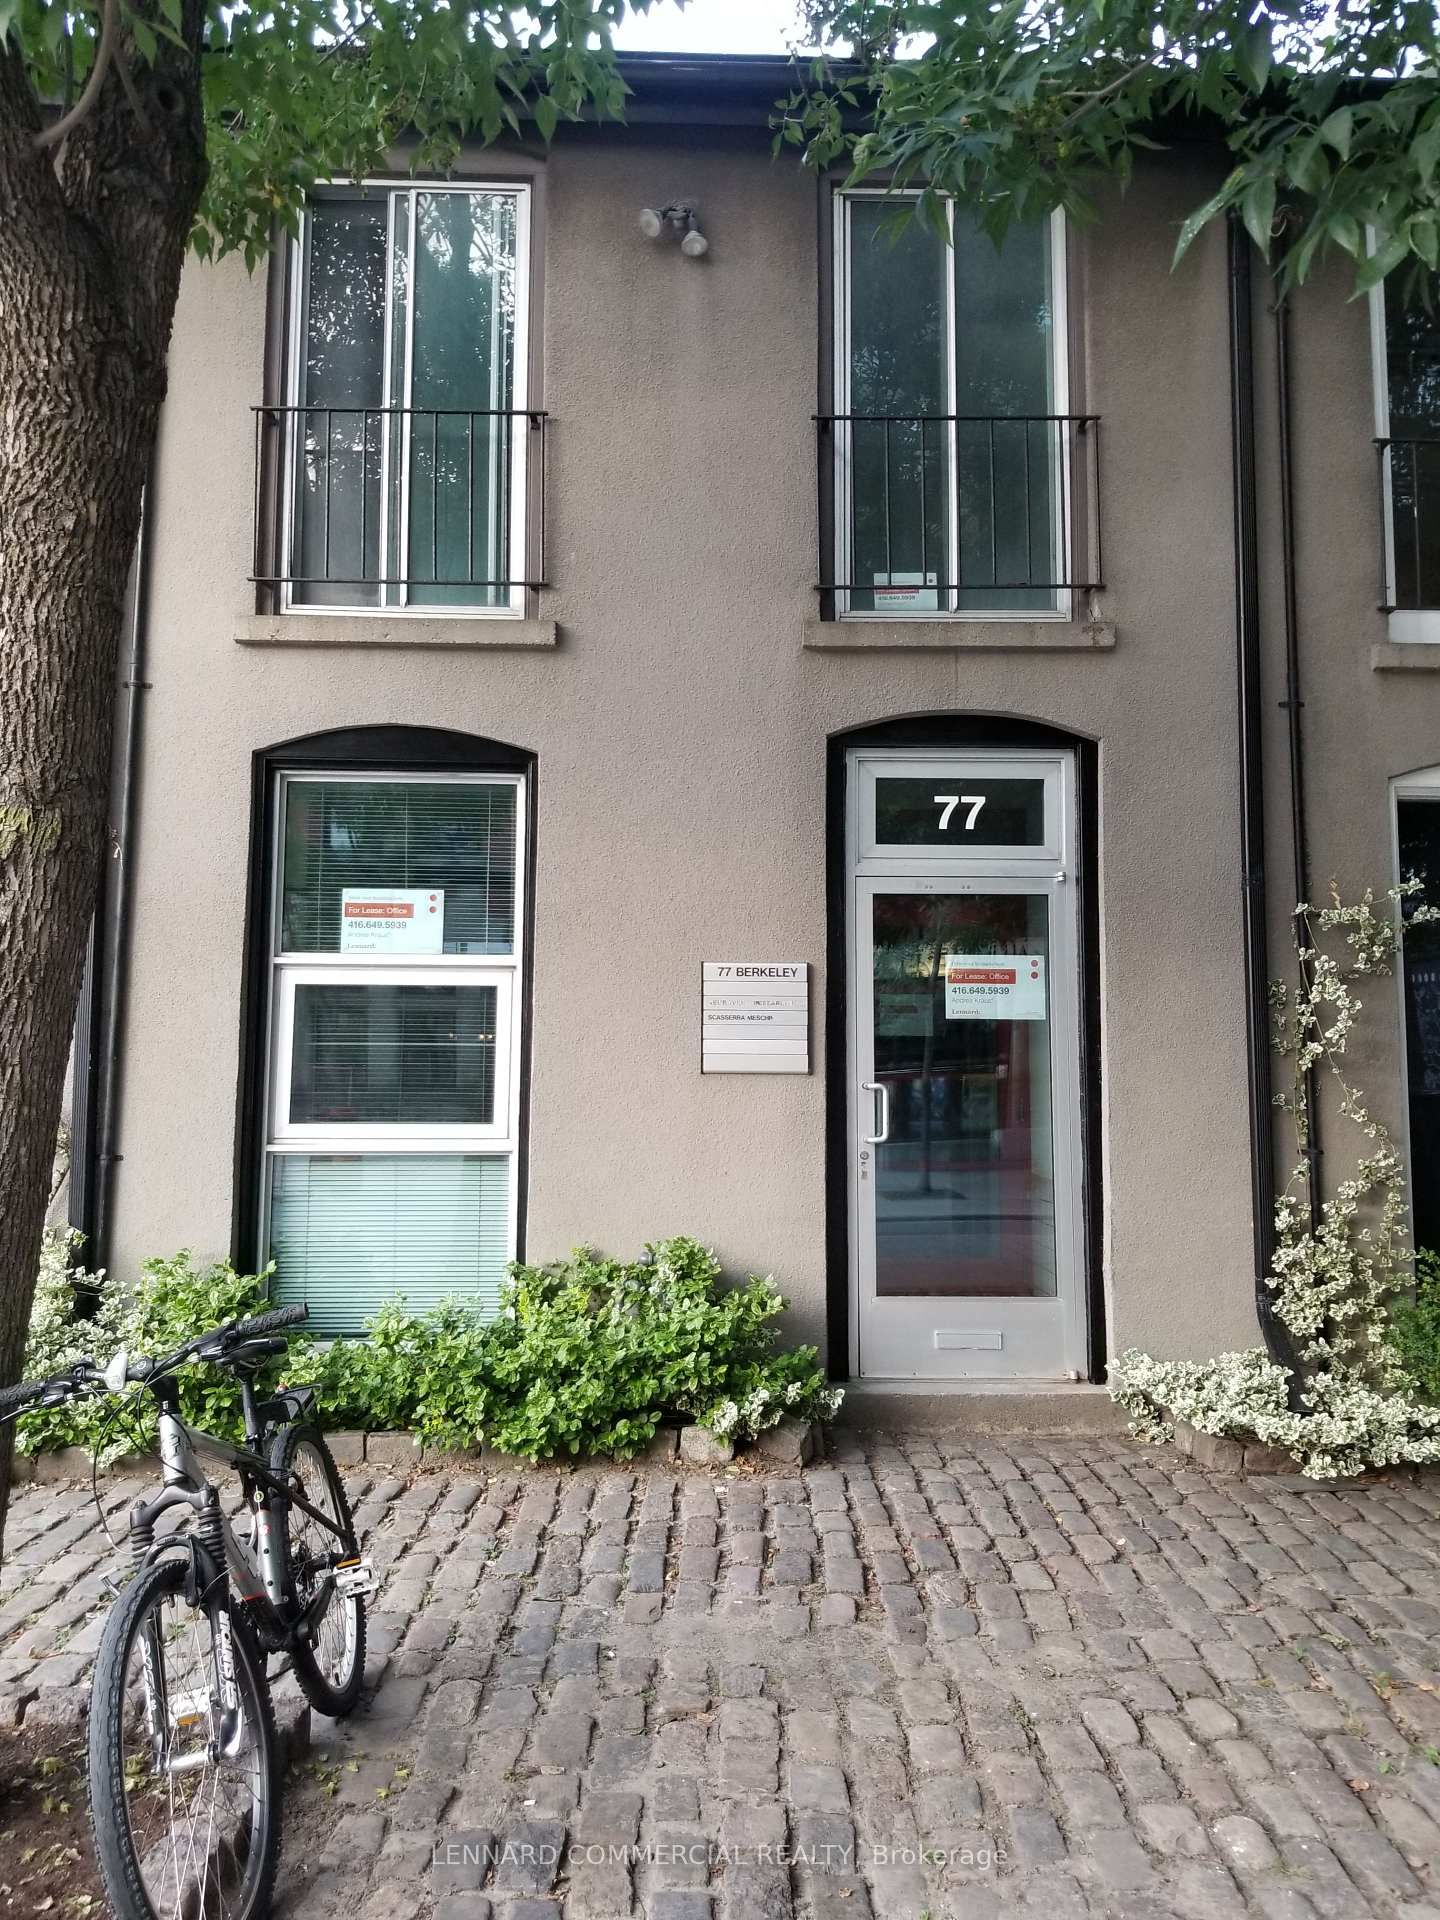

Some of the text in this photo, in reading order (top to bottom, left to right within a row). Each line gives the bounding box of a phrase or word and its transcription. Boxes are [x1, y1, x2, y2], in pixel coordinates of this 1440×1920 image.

[934, 796, 986, 830] 77
[348, 906, 361, 914] For
[386, 906, 408, 914] Office
[348, 921, 407, 929] 416.649.5939
[717, 967, 798, 977] 77 BERKELEY
[951, 987, 1010, 995] 416.649.5939
